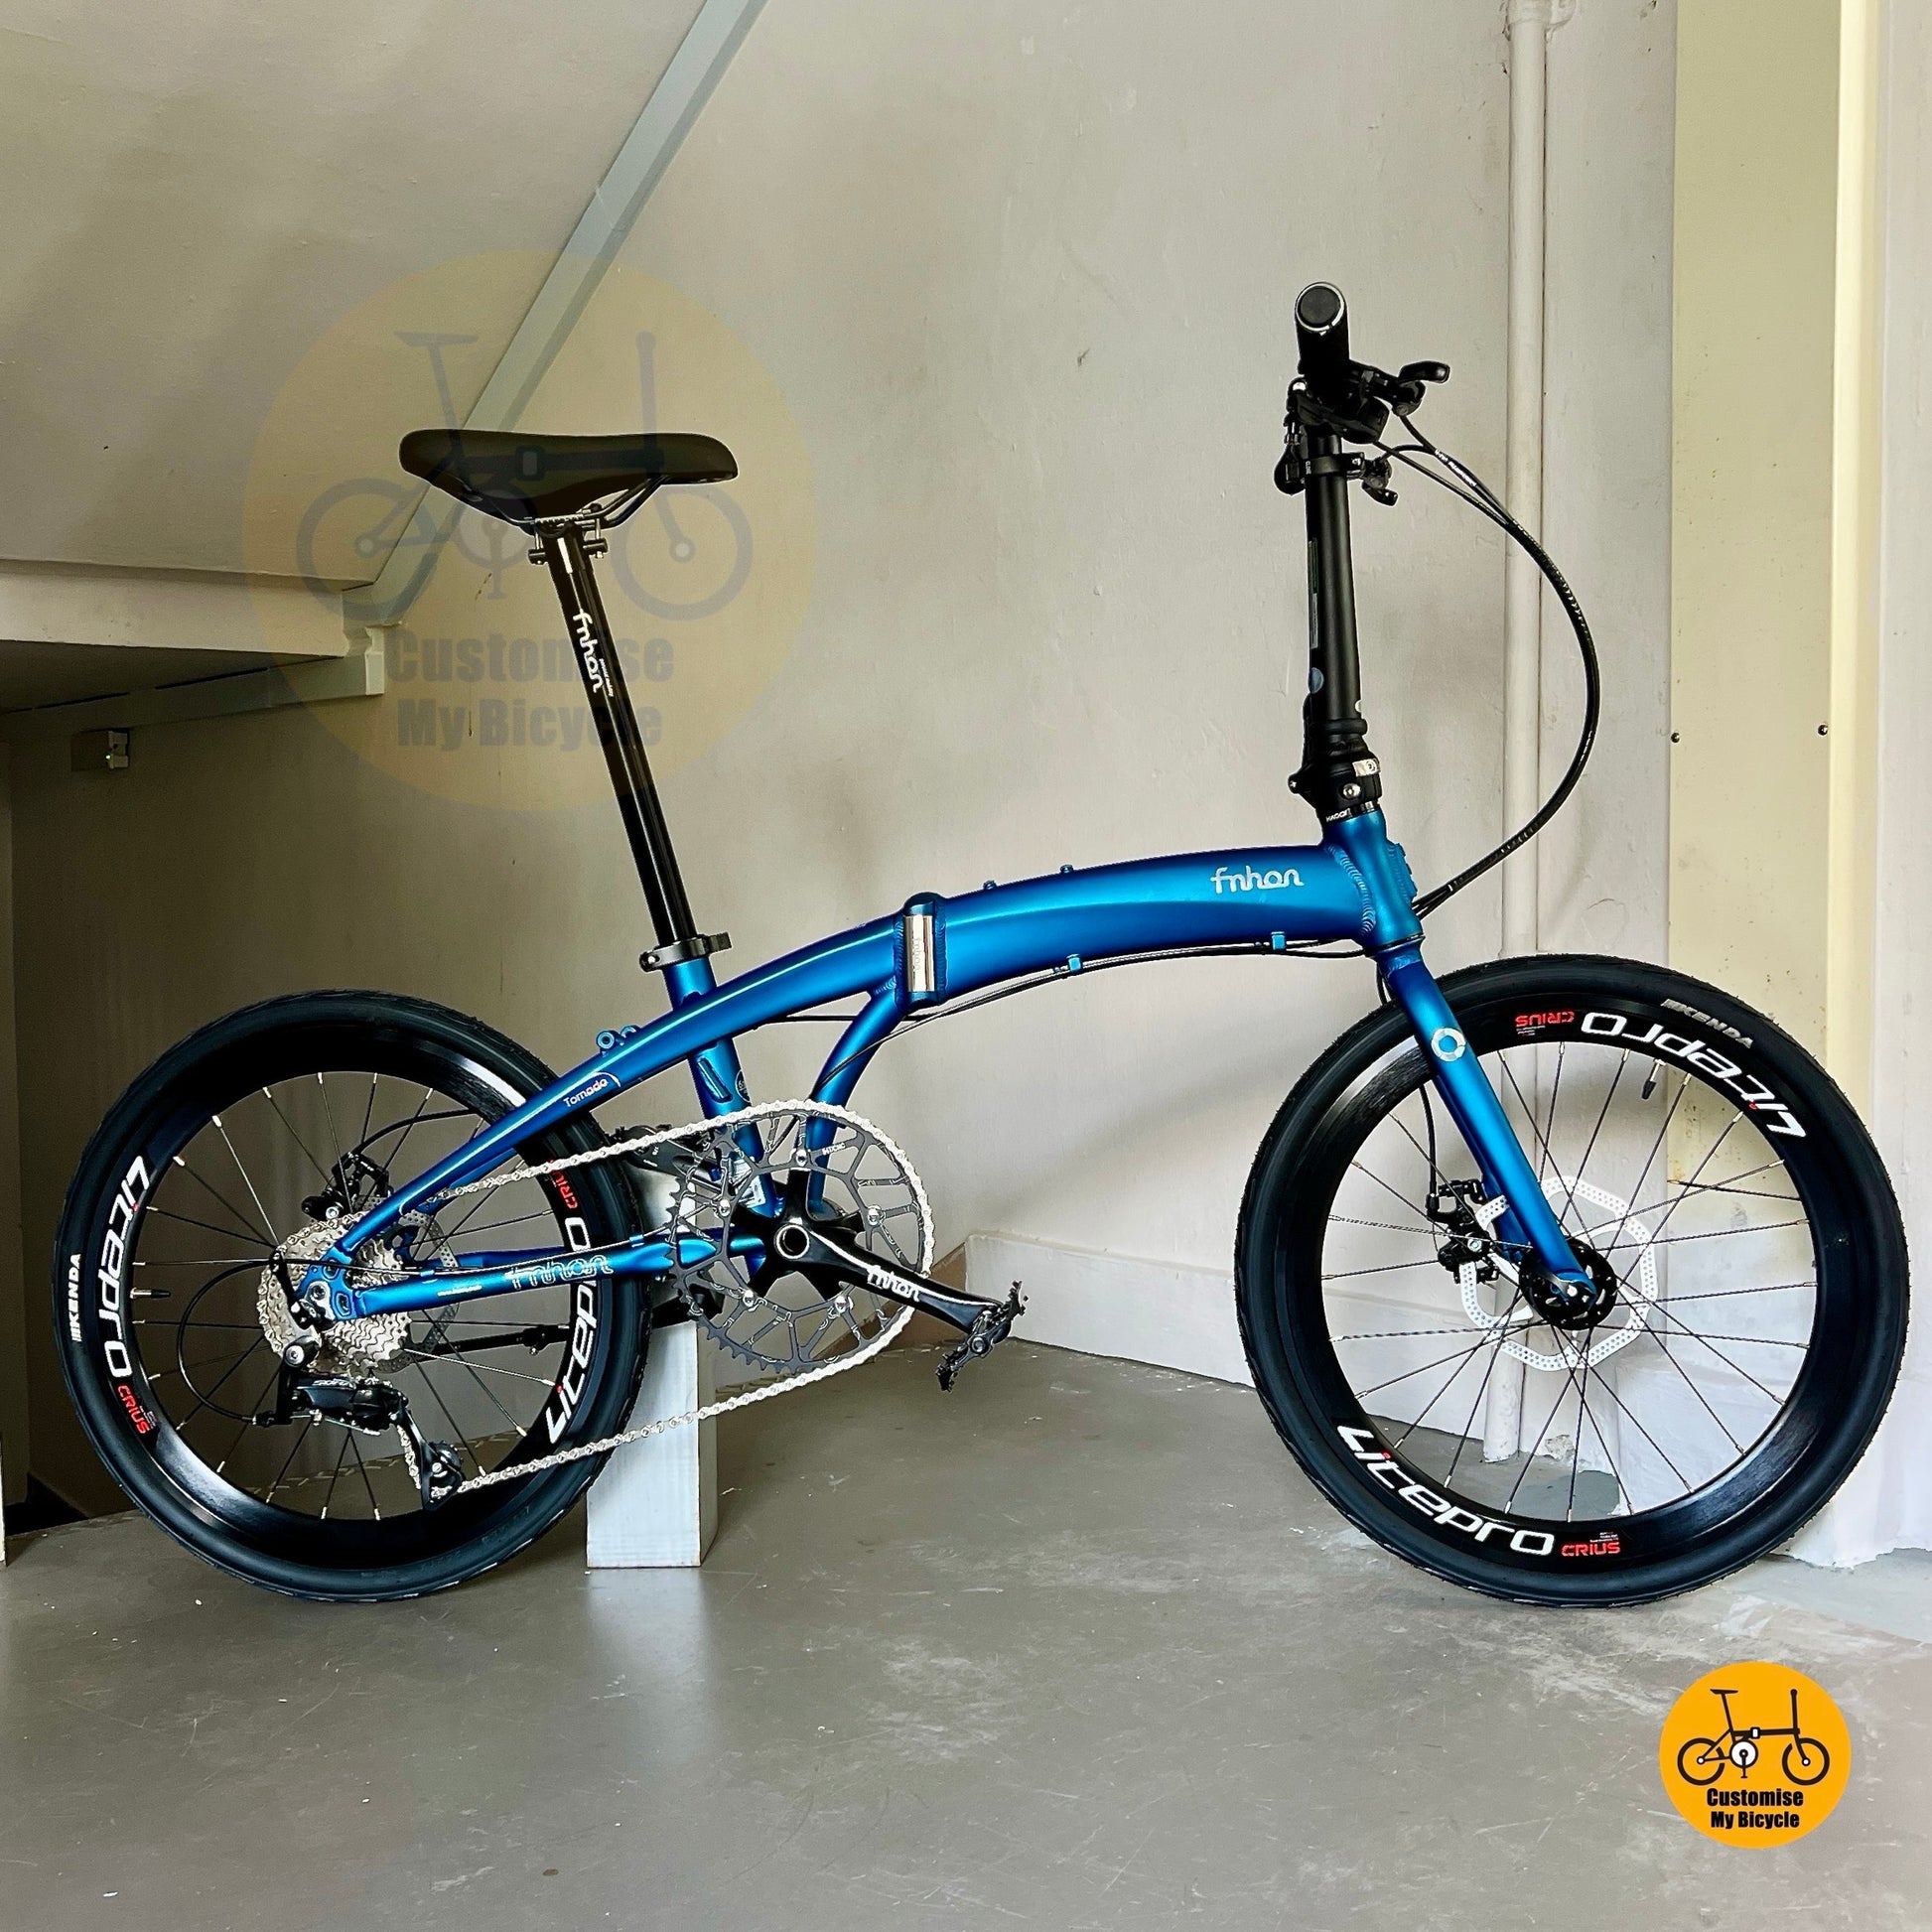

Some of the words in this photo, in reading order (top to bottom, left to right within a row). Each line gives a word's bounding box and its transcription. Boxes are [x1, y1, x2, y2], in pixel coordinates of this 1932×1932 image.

[1210, 865, 1305, 895] fnhon
[1514, 1011, 1576, 1028] CRIUS
[1670, 1000, 1754, 1049] KENDA
[1581, 1012, 1807, 1138] Litepro
[68, 1254, 81, 1332] KENDA
[98, 1156, 149, 1378] Litepro
[545, 1217, 597, 1444] Litepo
[117, 1384, 151, 1435] CRIUS
[1336, 1426, 1555, 1556] Litepro
[1562, 1542, 1621, 1557] CRIUS
